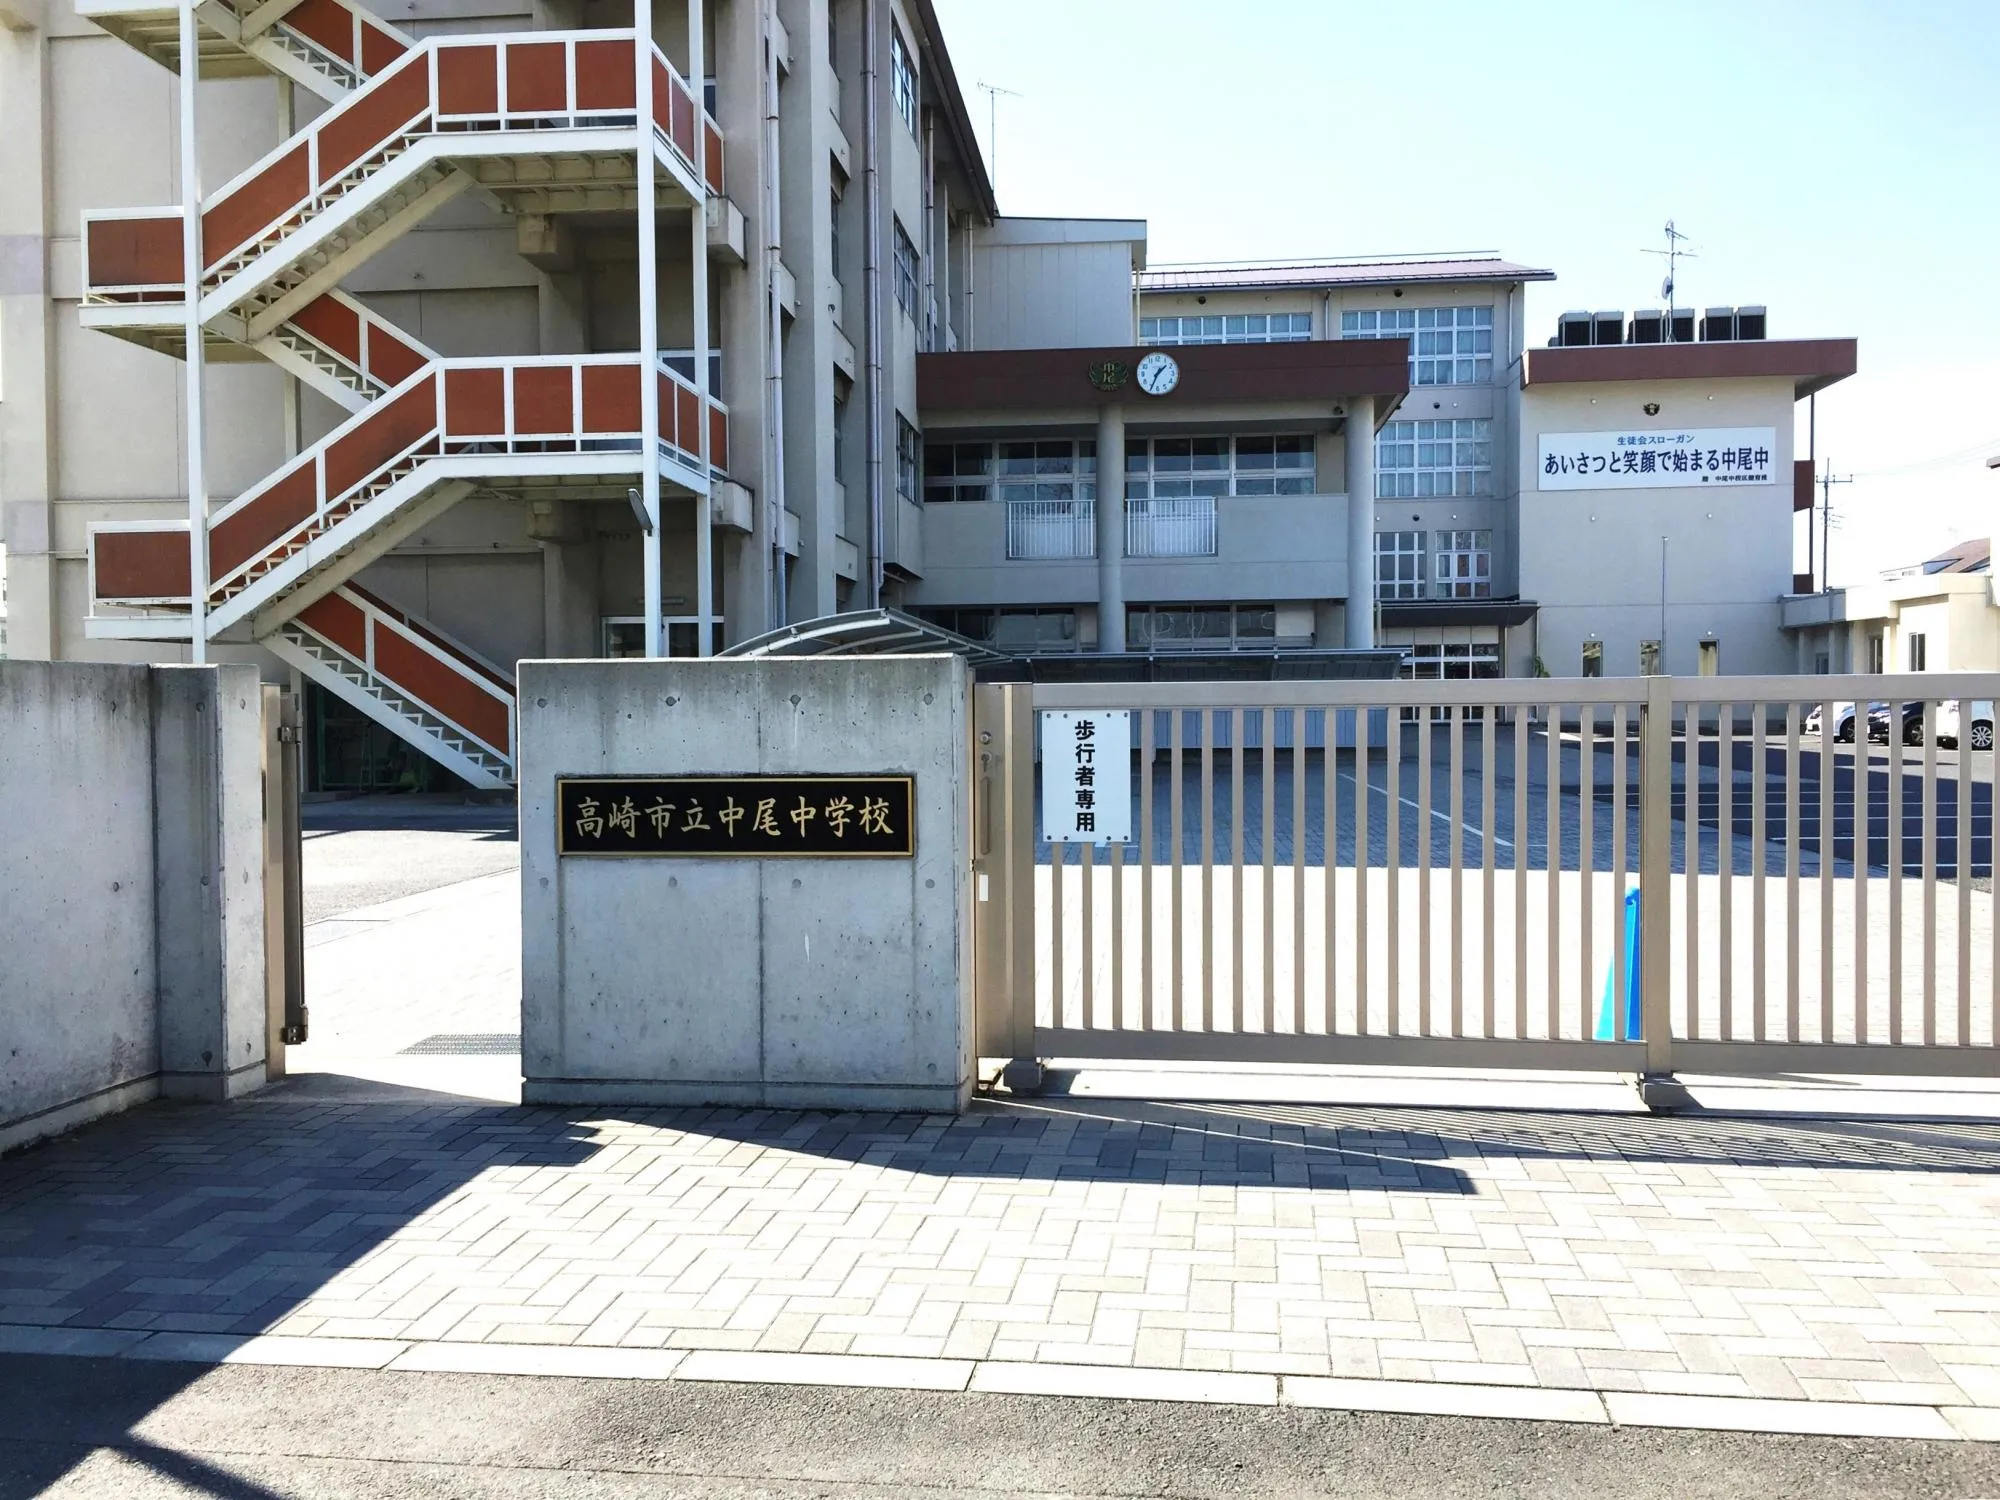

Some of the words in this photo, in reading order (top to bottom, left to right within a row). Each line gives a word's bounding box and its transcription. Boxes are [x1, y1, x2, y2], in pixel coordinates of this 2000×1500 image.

[1617, 434, 1695, 446] 生徒会スローガン
[1544, 446, 1769, 475] あいさつと笑顔で始まる中尾中
[1074, 719, 1096, 833] 歩行者専用
[575, 795, 895, 839] 高崎市立中尾中学校
